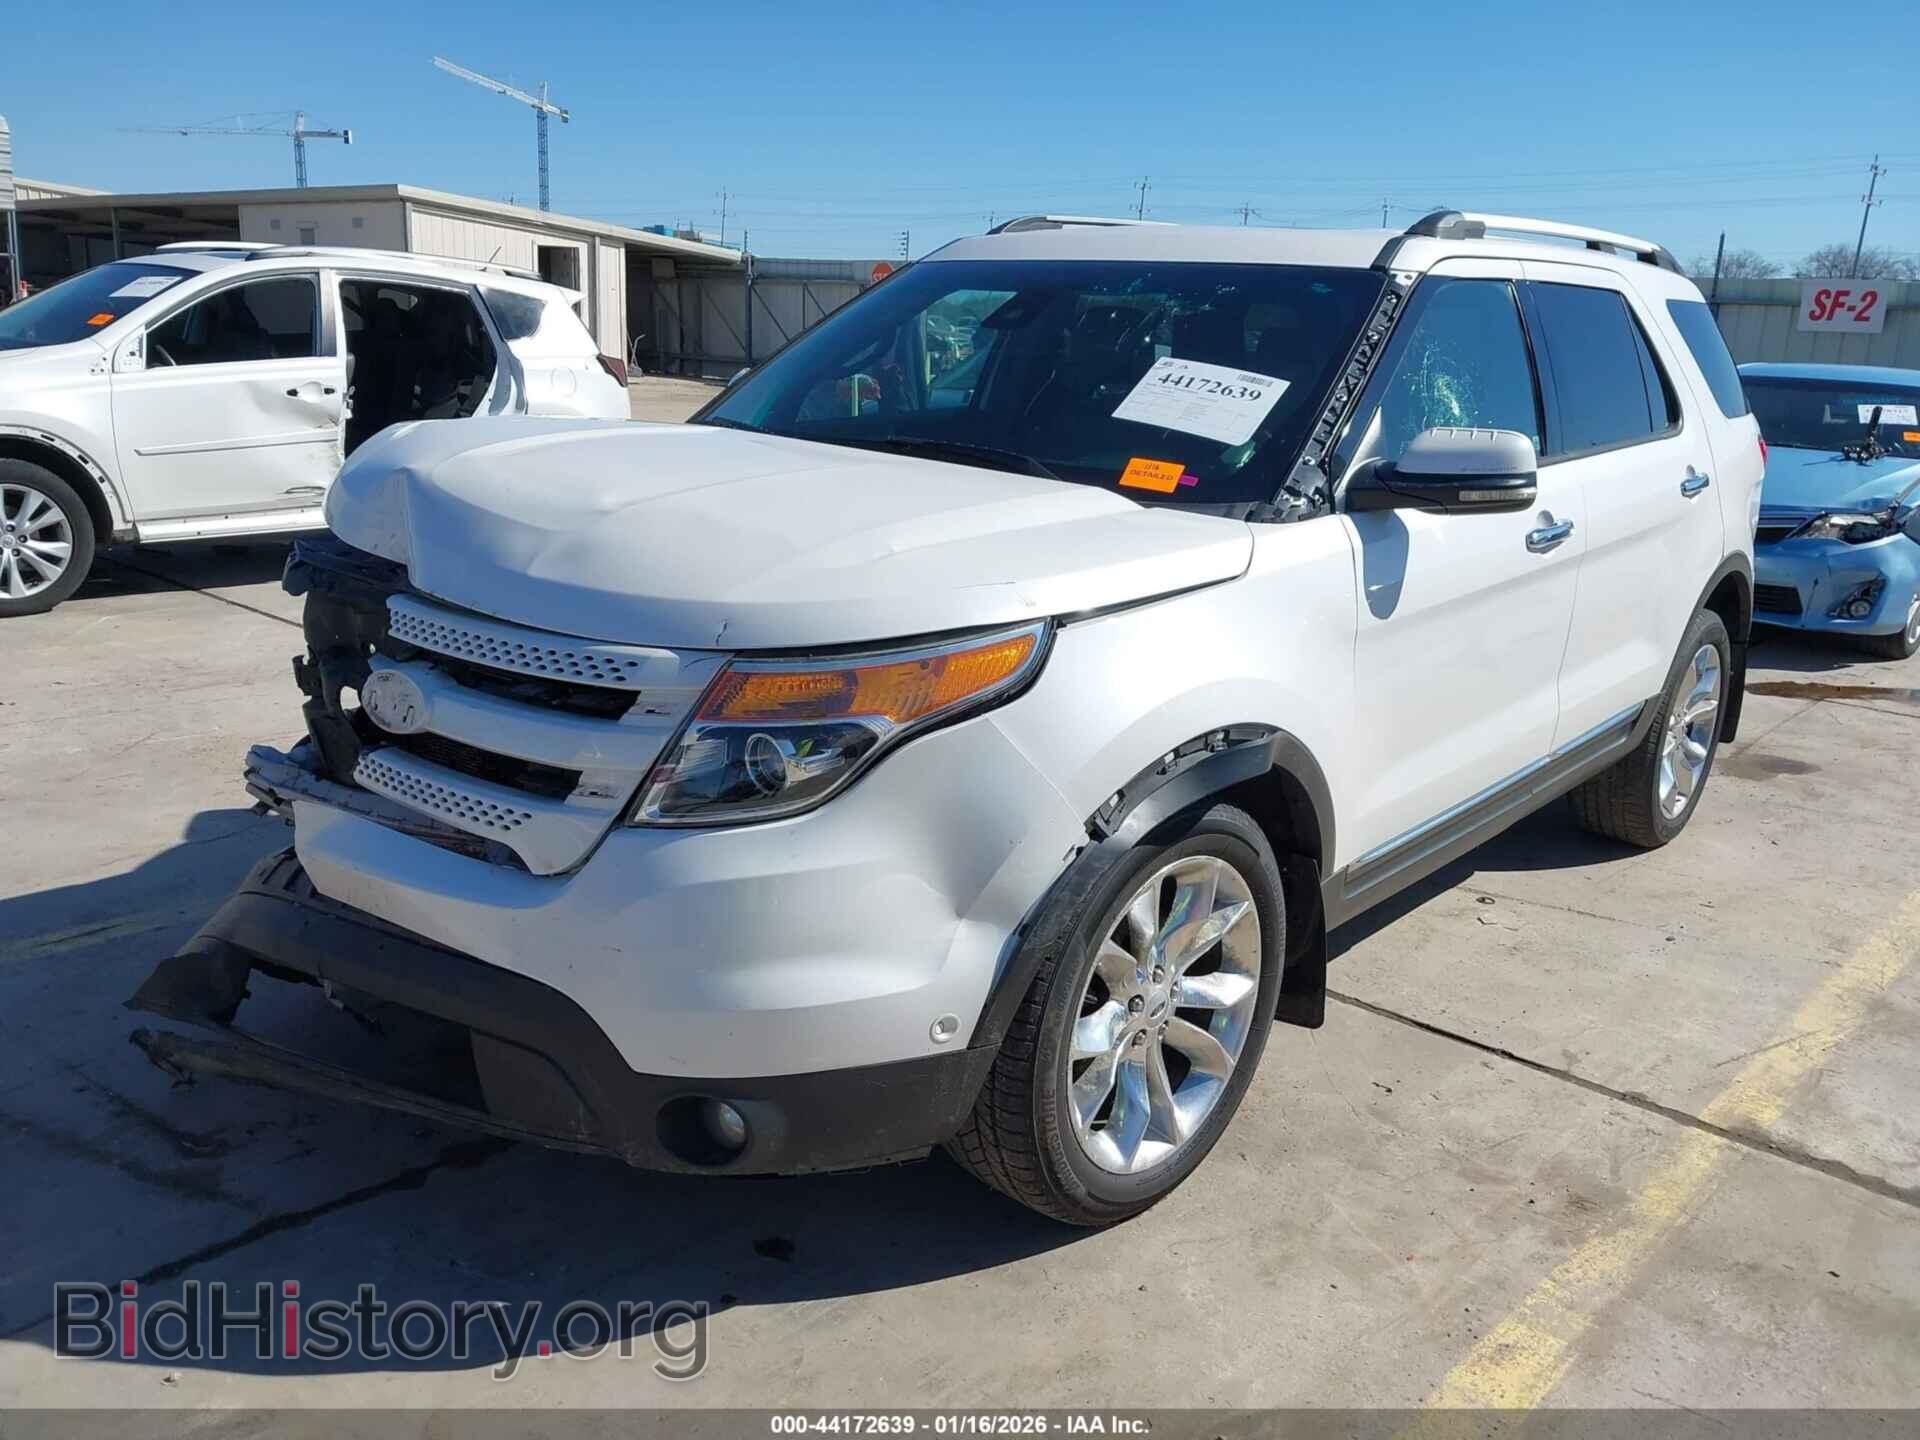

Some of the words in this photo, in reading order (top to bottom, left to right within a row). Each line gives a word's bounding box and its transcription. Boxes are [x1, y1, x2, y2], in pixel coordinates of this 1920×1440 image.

[1808, 288, 1878, 322] SF-2
[1158, 372, 1262, 400] 44172639
[1129, 469, 1174, 481] DETAILED
